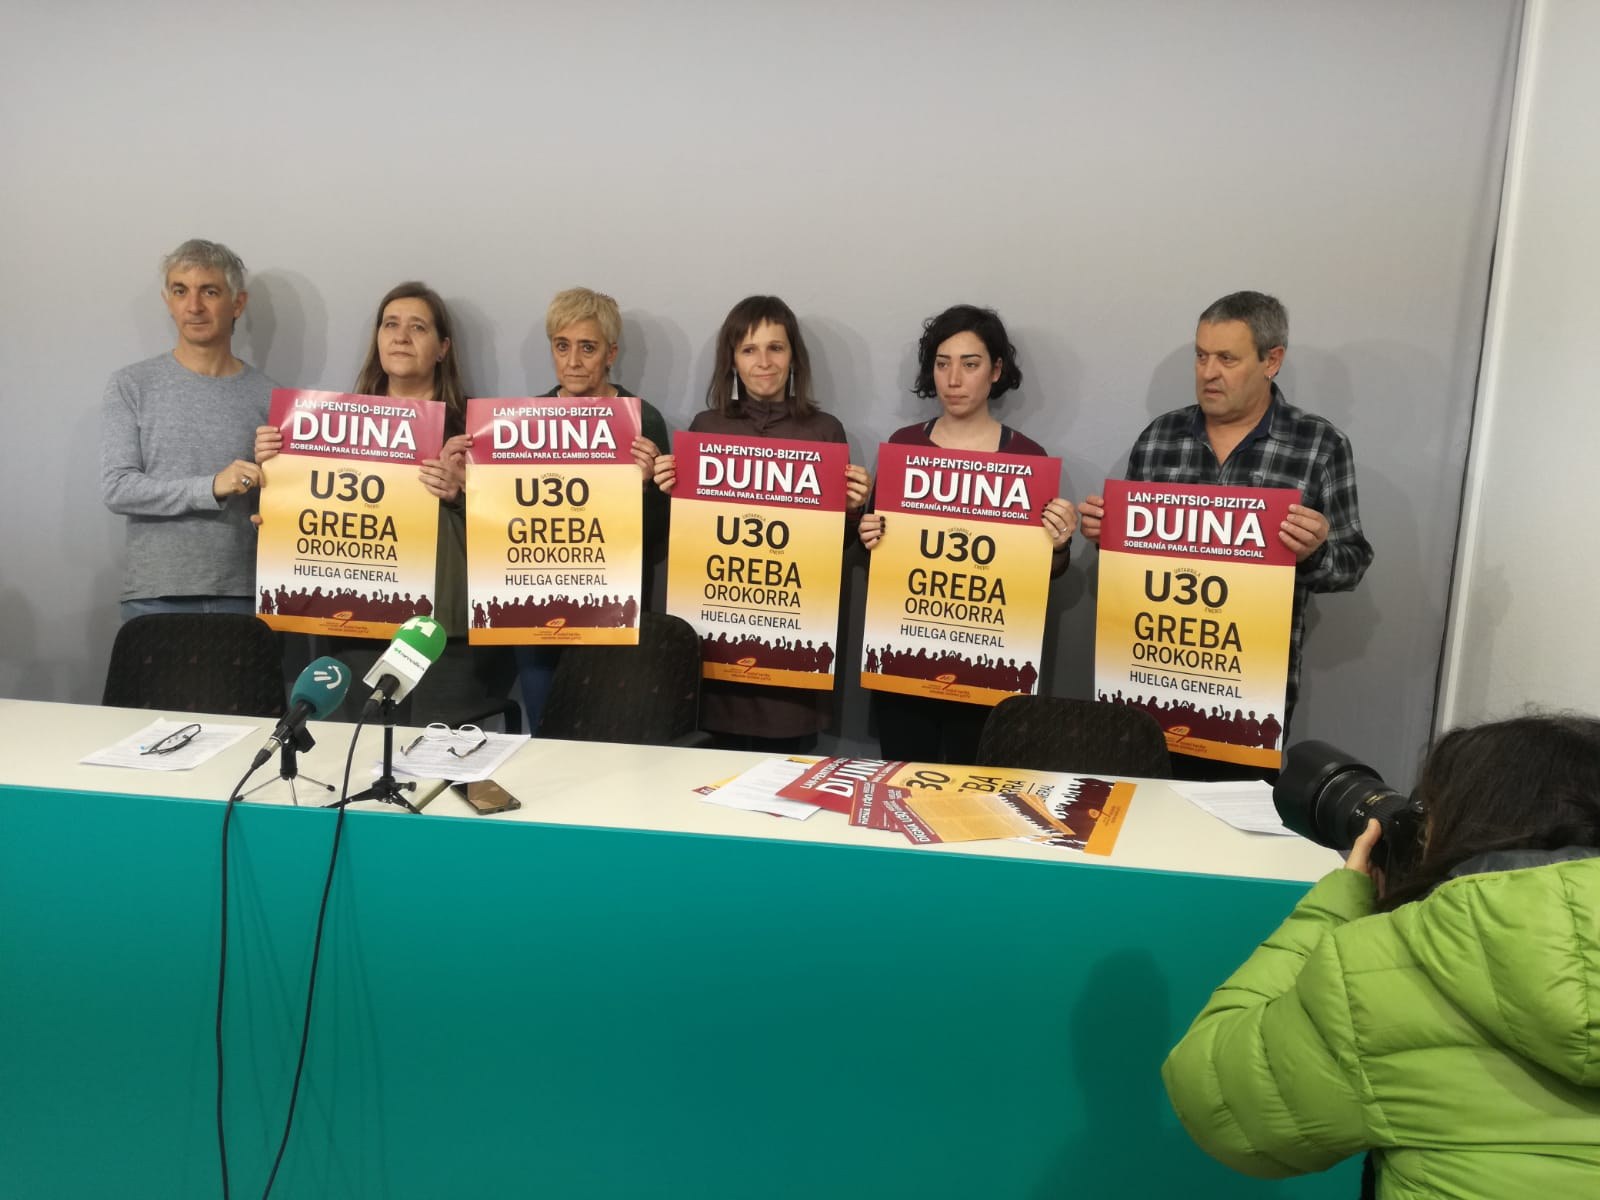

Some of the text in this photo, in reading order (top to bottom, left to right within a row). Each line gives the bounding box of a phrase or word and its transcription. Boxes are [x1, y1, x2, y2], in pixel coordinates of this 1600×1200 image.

[295, 398, 416, 418] LAN-PENTSIO-BIZITZA
[494, 407, 613, 417] LAN-PENTSIO-BIZITZA
[293, 411, 416, 450] DUINA
[493, 419, 616, 450] DUINA
[290, 443, 330, 453] SOBERANÍA
[332, 446, 350, 454] PARA
[361, 449, 388, 458] CAMBIO
[390, 451, 415, 459] SOCIAL
[492, 451, 532, 459] SOBERANÍA
[700, 443, 820, 462] LAN-PENTSIO-BIZITZA
[699, 455, 821, 495] DUINA
[906, 455, 1032, 476] LAN-PENTSIO-BIZITZA
[310, 470, 385, 504] U30
[516, 478, 589, 506] U30
[697, 488, 735, 497] SOBERANÍA
[766, 494, 792, 502] CAMBIO
[794, 496, 820, 504] SOCIAL
[903, 468, 1030, 510] DUINA
[901, 501, 941, 511] SOBERANÍA
[942, 505, 961, 513] PARA
[972, 508, 1000, 517] CAMBIO
[1002, 511, 1029, 520] SOCIAL
[1128, 492, 1266, 510] LAN-PENTSIO-BIZITZA
[299, 509, 398, 542] GREBA
[508, 518, 605, 544] GREBA
[717, 516, 789, 549] U30
[1126, 505, 1266, 548] DUINA
[297, 538, 398, 561] OROKORRA
[507, 548, 605, 563] OROKORRA
[920, 529, 995, 564] U30
[1124, 540, 1166, 550] SOBERANÍA
[1168, 544, 1188, 552] PARA
[1200, 547, 1232, 555] CAMBIO
[1234, 549, 1264, 558] SOCIAL
[294, 565, 398, 583] HUELGA GENERAL
[506, 575, 607, 586] HUELGA GENERAL
[706, 554, 801, 588] GREBA
[704, 584, 800, 608] OROKORRA
[908, 569, 1006, 605] GREBA
[1145, 570, 1228, 608] U30
[701, 610, 801, 630] HUELGA GENERAL
[905, 598, 1005, 625] OROKORRA
[901, 624, 1004, 648] HUELGA GENERAL
[1134, 612, 1242, 652] GREBA
[1133, 642, 1241, 673] OROKORRA
[1130, 671, 1242, 699] HUELGA GENERAL
[906, 770, 951, 791] 30
